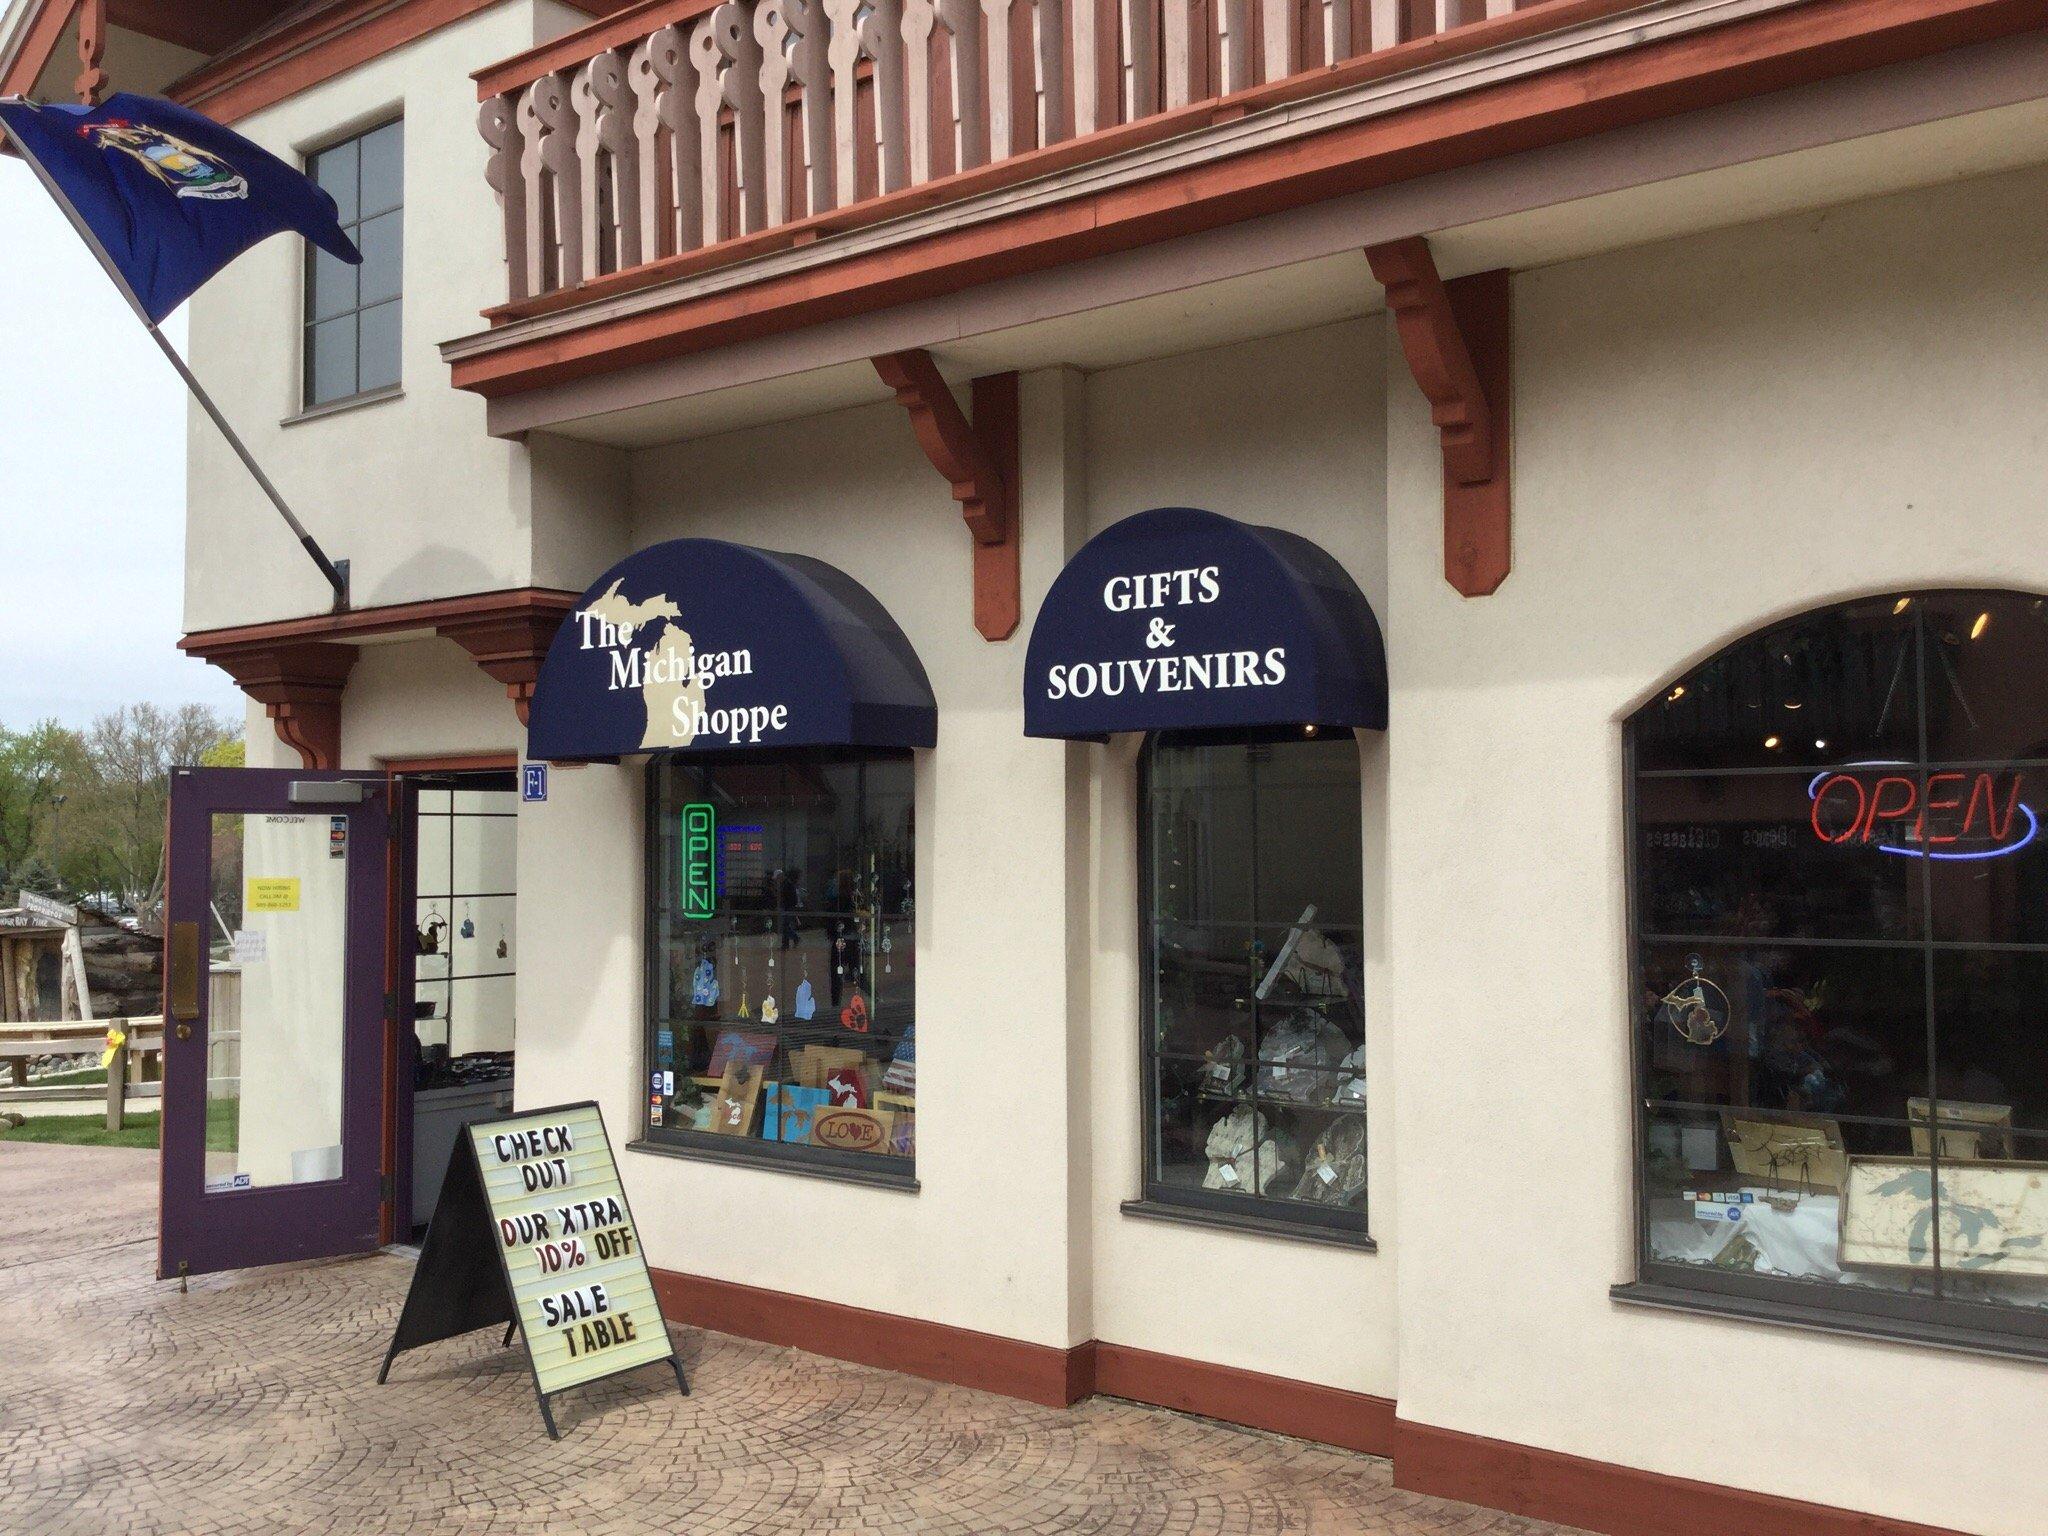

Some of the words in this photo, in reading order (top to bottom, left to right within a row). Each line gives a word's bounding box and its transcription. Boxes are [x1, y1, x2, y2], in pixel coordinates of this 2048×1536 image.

[1103, 565, 1220, 612] GIFTS
[575, 611, 633, 650] The
[1145, 616, 1176, 649] &
[608, 646, 753, 690] Michigan
[1047, 647, 1286, 700] SOUVENIRS
[671, 695, 788, 744] Shoppe
[1811, 773, 2022, 843] OPEN
[689, 812, 709, 911] OPEN
[494, 1125, 573, 1163] CHECK
[520, 1158, 567, 1192] OUT
[499, 1212, 550, 1248] OUR
[557, 1197, 623, 1236] XTRA
[536, 1239, 585, 1274] 10%
[594, 1226, 633, 1260] OFF
[542, 1284, 608, 1328] SALE
[562, 1312, 637, 1357] TABLE
